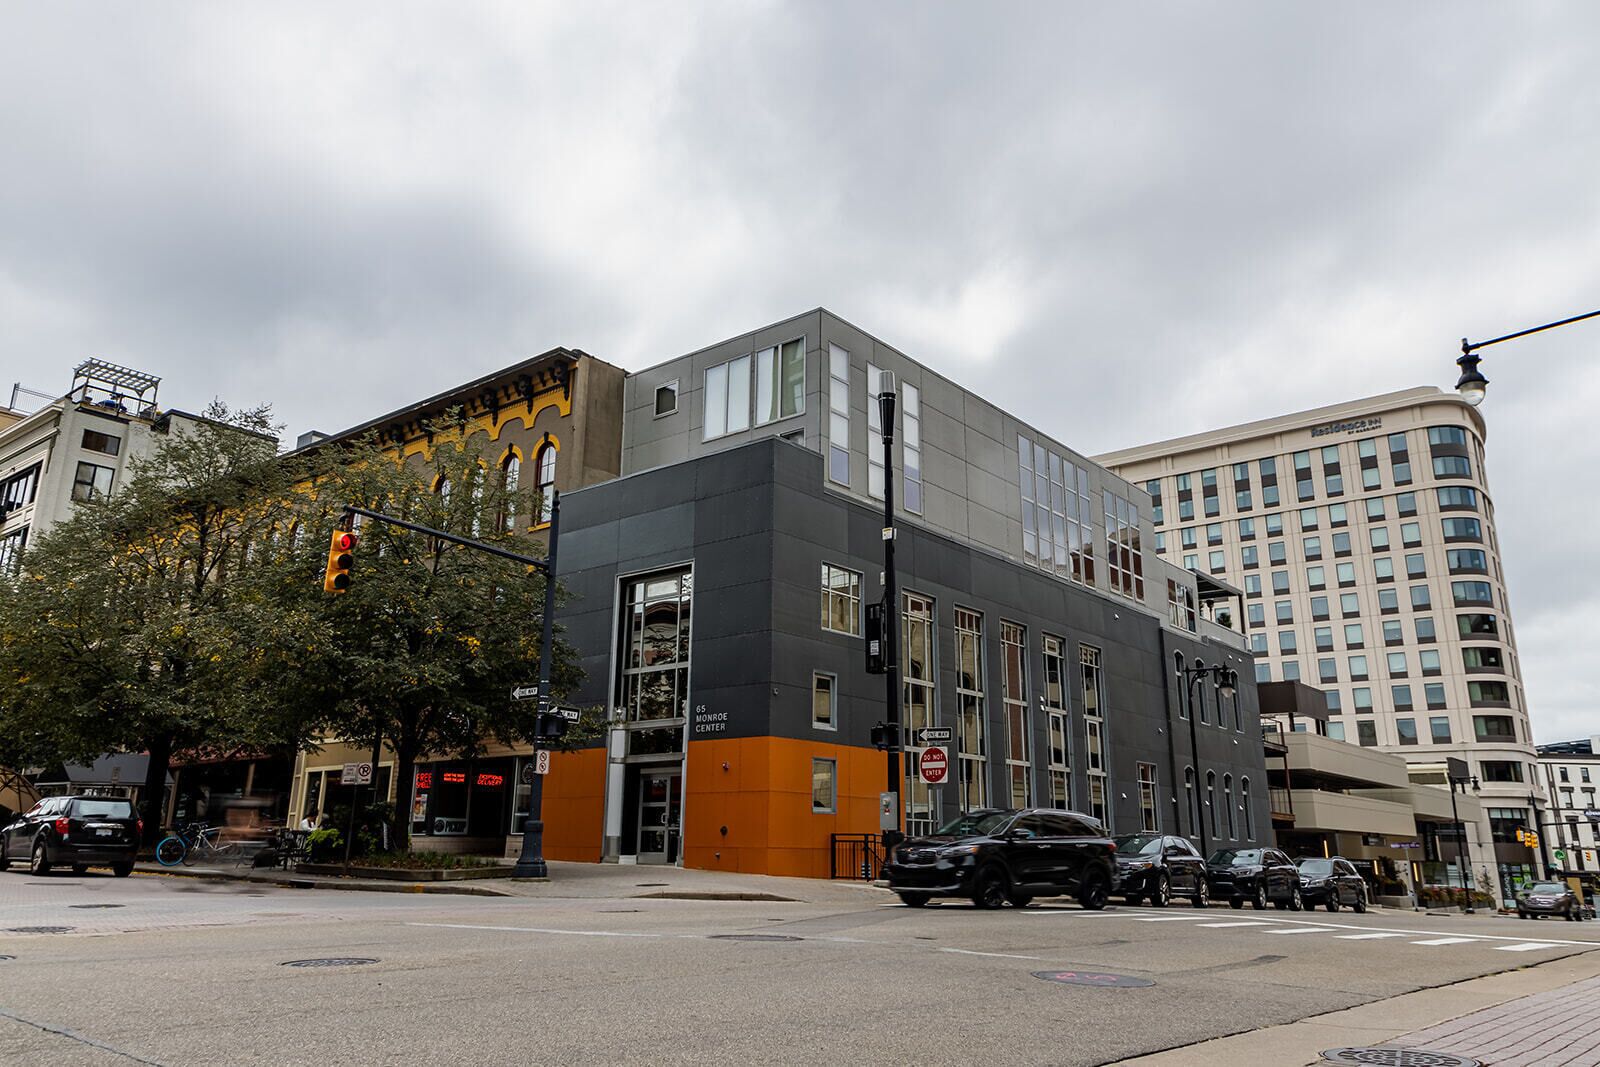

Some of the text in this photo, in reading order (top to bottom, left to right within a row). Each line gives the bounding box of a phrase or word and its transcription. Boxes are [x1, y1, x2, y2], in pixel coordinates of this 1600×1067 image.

[1311, 420, 1367, 438] Residence
[696, 705, 706, 713] 65
[696, 713, 728, 722] MONROE
[696, 723, 726, 732] CENTER
[925, 769, 942, 777] ENTER
